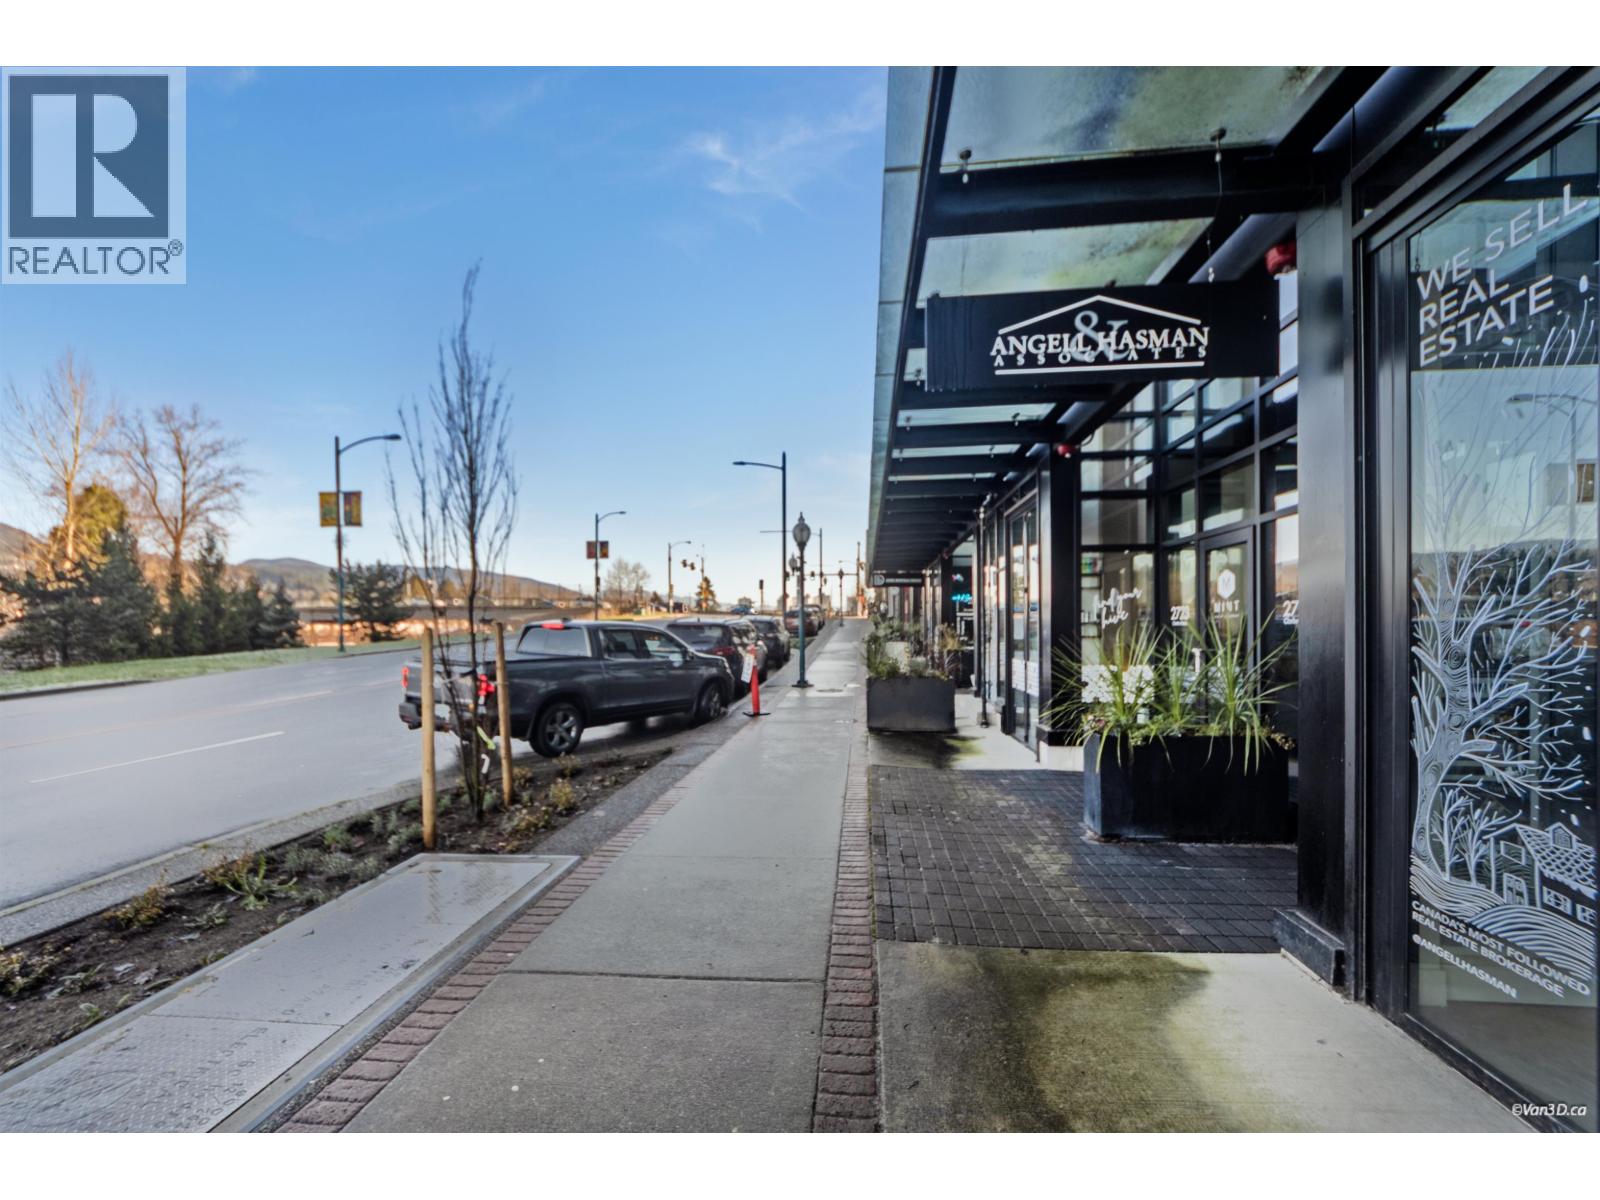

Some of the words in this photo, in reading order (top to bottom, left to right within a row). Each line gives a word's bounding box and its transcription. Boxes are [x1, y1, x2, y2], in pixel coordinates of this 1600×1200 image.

[1417, 247, 1472, 300] WE
[1485, 184, 1588, 262] SELL
[1420, 269, 1509, 335] REAL
[1420, 275, 1554, 368] ESTATE
[990, 332, 1092, 357] ANGELL
[1098, 327, 1210, 351] HASMAN
[993, 346, 1207, 367] ASSOCIATES
[1412, 901, 1467, 934] CANADA'S
[1468, 929, 1505, 953] MOST
[1507, 946, 1591, 996] FOLLOWED
[1412, 911, 1438, 932] REAL
[1439, 925, 1479, 953] ESTATE
[1481, 946, 1565, 998] BROKERAGE
[1412, 934, 1518, 998] @ANGELLHASMAN
